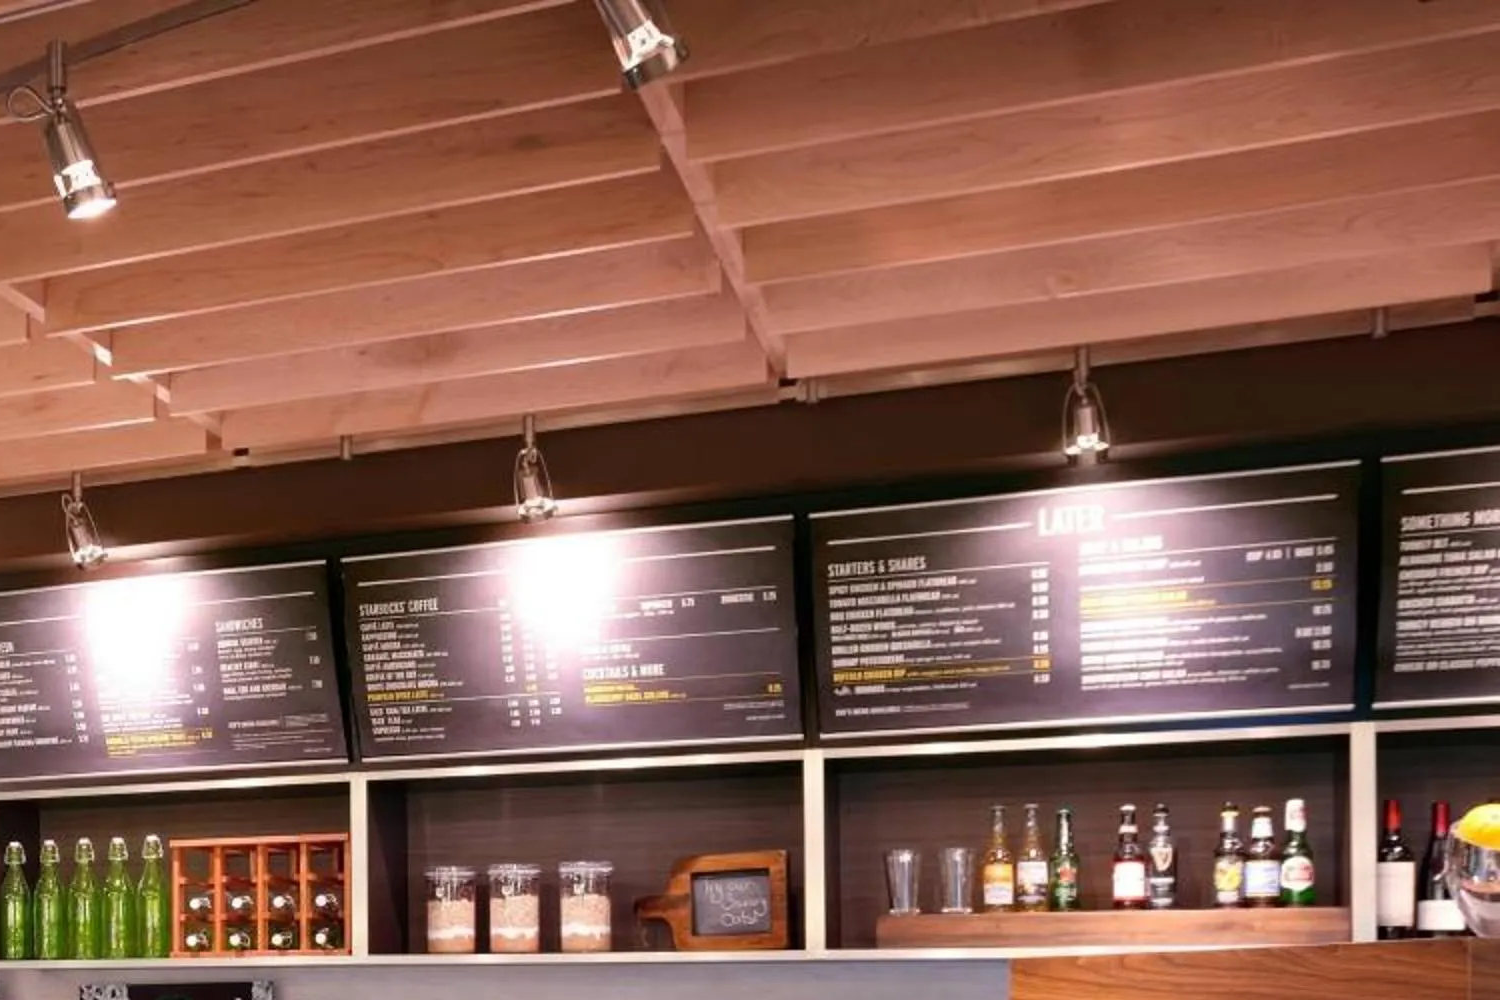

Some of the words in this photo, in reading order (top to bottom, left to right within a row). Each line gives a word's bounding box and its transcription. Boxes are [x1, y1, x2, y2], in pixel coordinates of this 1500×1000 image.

[1038, 505, 1105, 536] LATER
[1401, 512, 1471, 531] SOMETHING
[827, 560, 875, 577] STARTERS
[878, 560, 885, 574] &
[888, 555, 927, 572] SHARES
[407, 598, 439, 612] COFFEE
